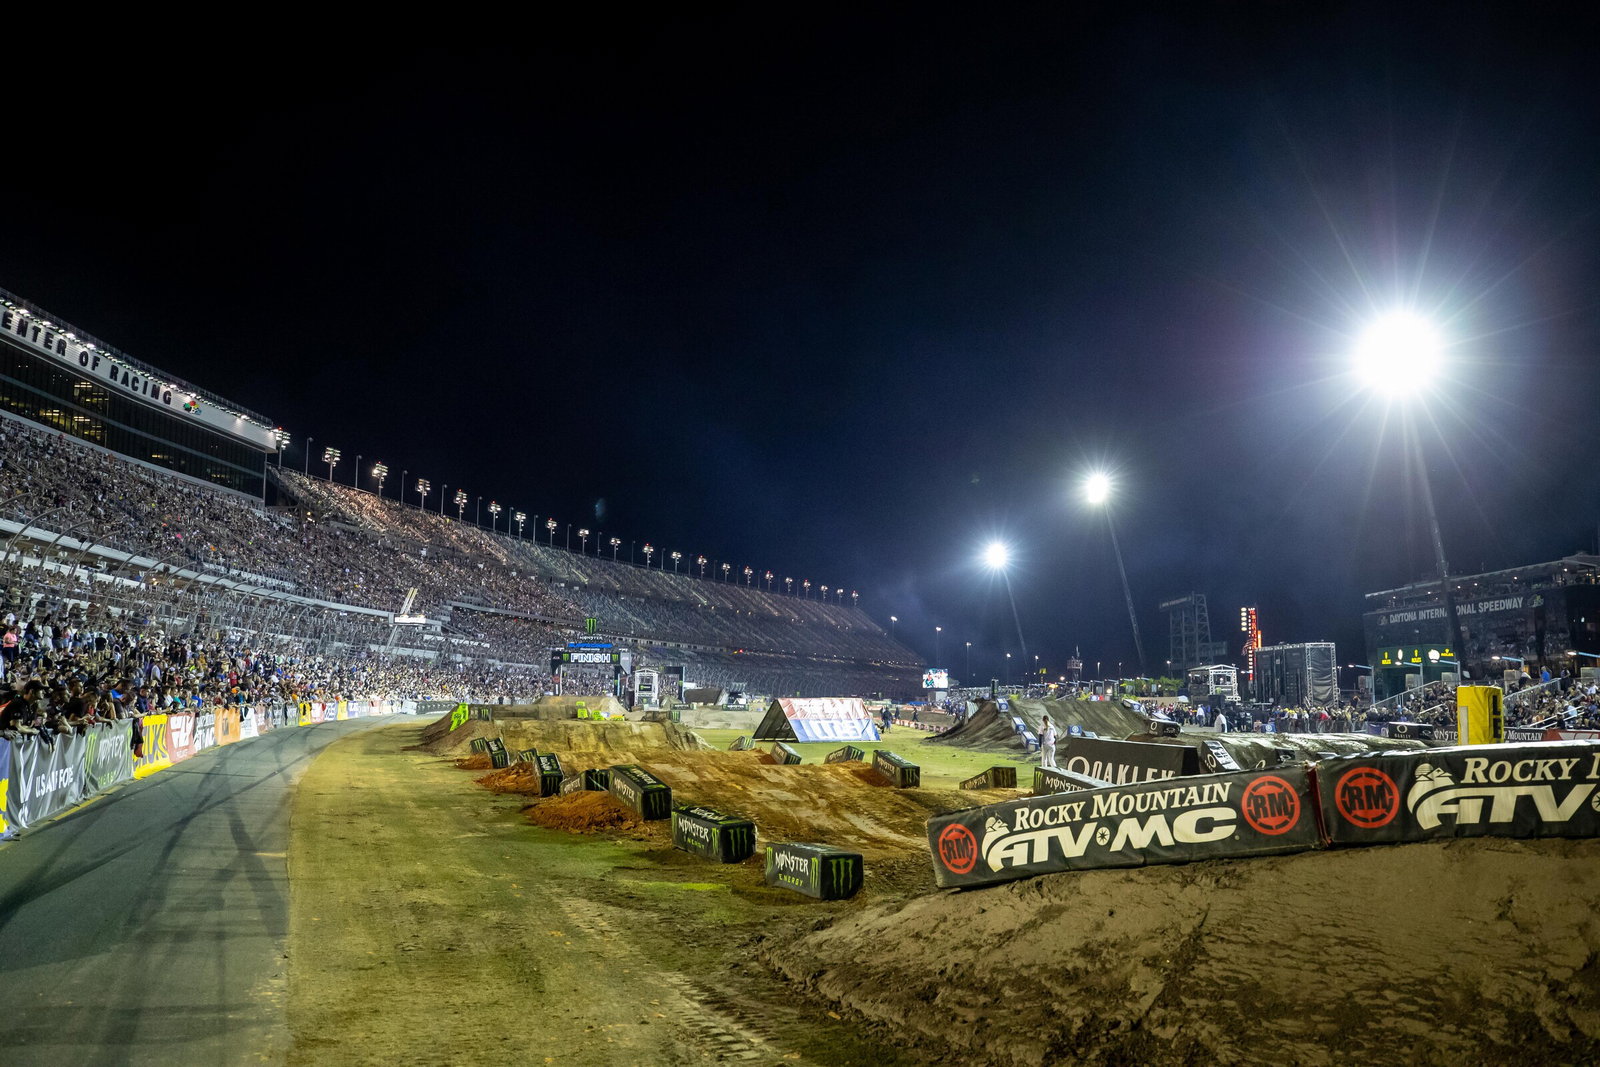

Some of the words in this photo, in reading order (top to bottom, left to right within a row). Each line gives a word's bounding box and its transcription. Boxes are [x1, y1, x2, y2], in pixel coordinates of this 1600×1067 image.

[1, 311, 67, 356] ENTER
[79, 351, 100, 371] OF
[109, 364, 173, 405] RACING
[1389, 612, 1417, 624] DAYTONA
[1418, 603, 1477, 620] INTERNONAL
[1478, 597, 1524, 613] SPEEDWAY
[570, 653, 611, 663] FINISH
[1045, 776, 1088, 792] MONSTE
[1461, 757, 1581, 784] ROCKY
[1013, 801, 1086, 831] ROCKY
[1089, 782, 1233, 819] MOUNTAIN
[678, 817, 710, 843] MONSTER
[775, 850, 808, 877] MONSTER
[778, 873, 803, 887] ENERGY
